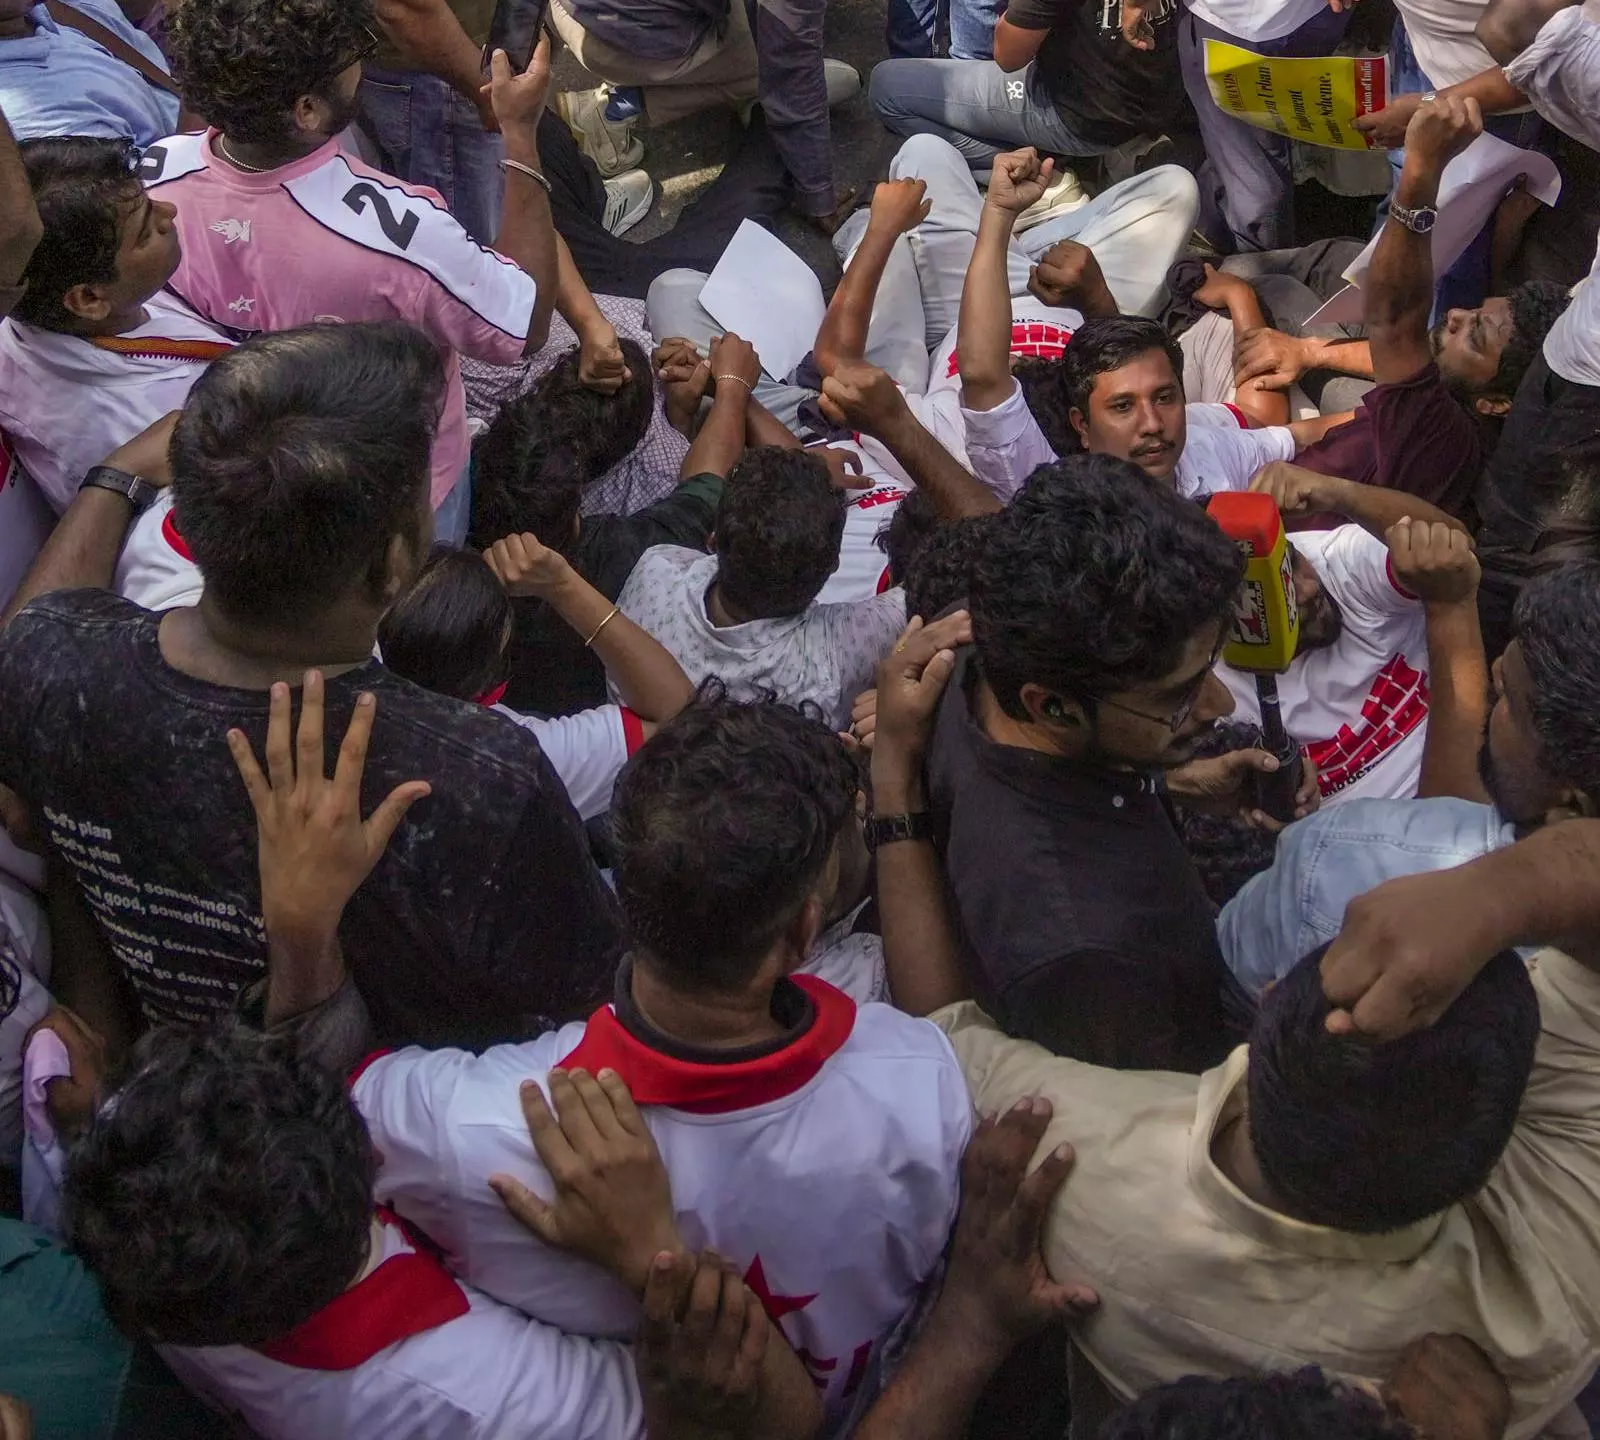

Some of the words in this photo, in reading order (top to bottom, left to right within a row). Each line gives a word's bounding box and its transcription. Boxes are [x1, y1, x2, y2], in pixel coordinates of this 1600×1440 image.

[1361, 60, 1373, 80] India
[342, 182, 420, 251] 2
[1255, 580, 1268, 612] FOUR
[1259, 612, 1272, 646] TWENTY
[79, 821, 112, 841] plan
[87, 846, 121, 865] plan
[104, 891, 146, 915] good,
[150, 903, 240, 934] sometimes
[144, 881, 237, 917] sometimes
